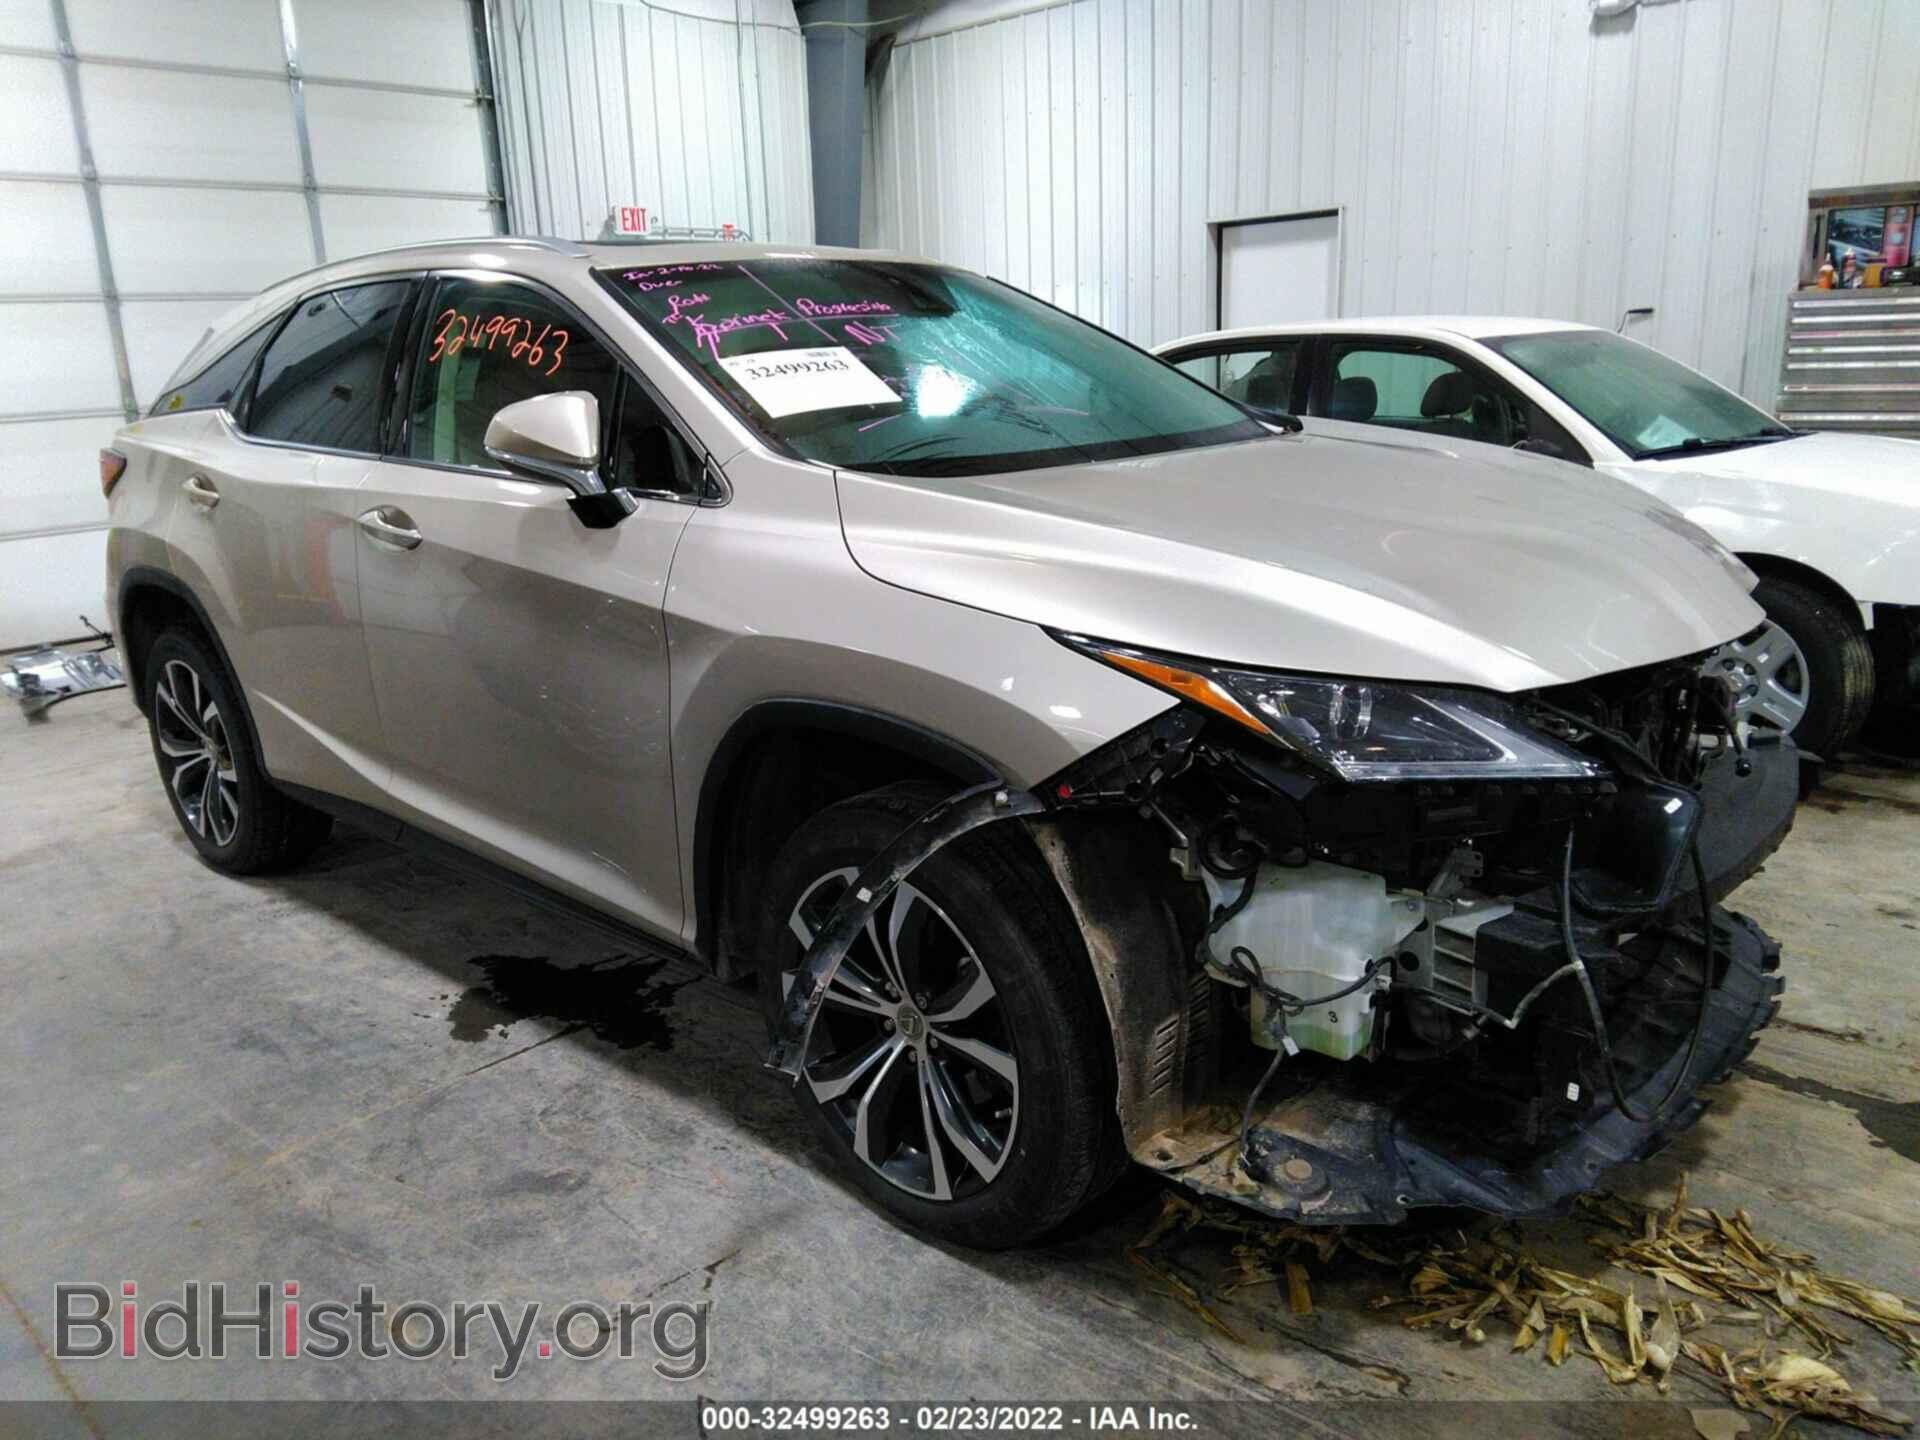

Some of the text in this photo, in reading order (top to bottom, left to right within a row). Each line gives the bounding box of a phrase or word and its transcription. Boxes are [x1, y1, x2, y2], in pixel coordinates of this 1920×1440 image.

[620, 207, 647, 232] EXIT
[429, 308, 569, 376] 32499263
[745, 359, 850, 381] 32499263
